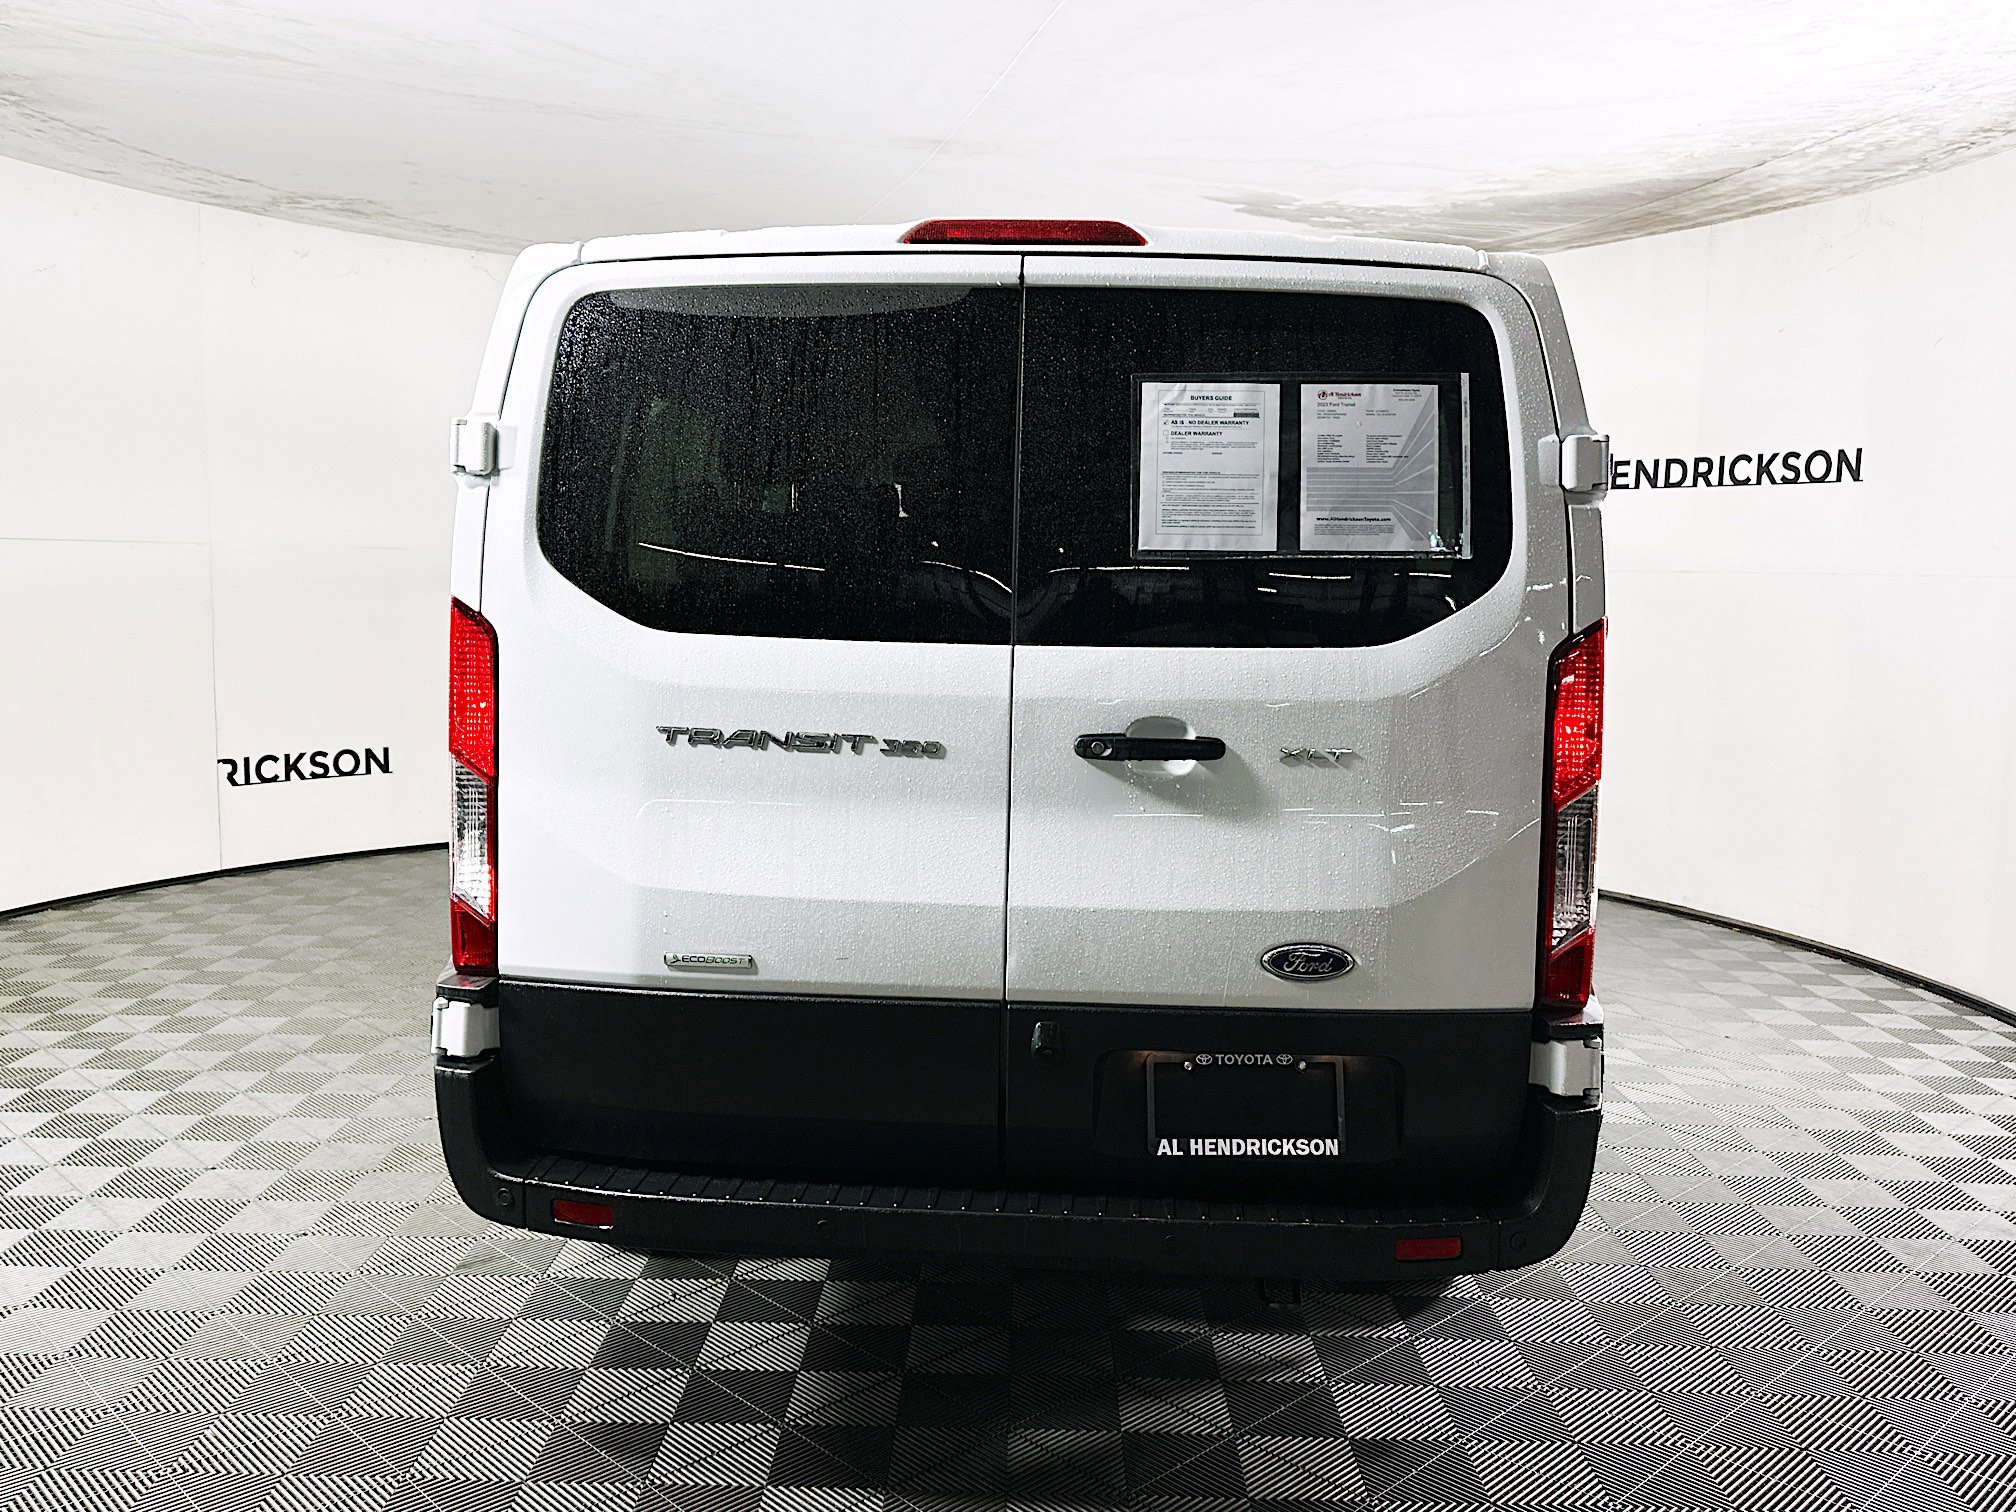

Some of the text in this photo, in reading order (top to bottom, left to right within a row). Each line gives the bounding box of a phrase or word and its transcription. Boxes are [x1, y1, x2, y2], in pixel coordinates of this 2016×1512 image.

[1610, 448, 1863, 489] ENDRICKSON
[655, 726, 877, 754] TRANSIT
[1279, 747, 1356, 765] XLT
[217, 747, 393, 786] RICKSON
[681, 954, 746, 965] ECOBOOST
[1283, 951, 1334, 972] Ford
[1215, 1054, 1273, 1065] TOYOTA
[1156, 1139, 1339, 1156] AL HENDRICKSON
